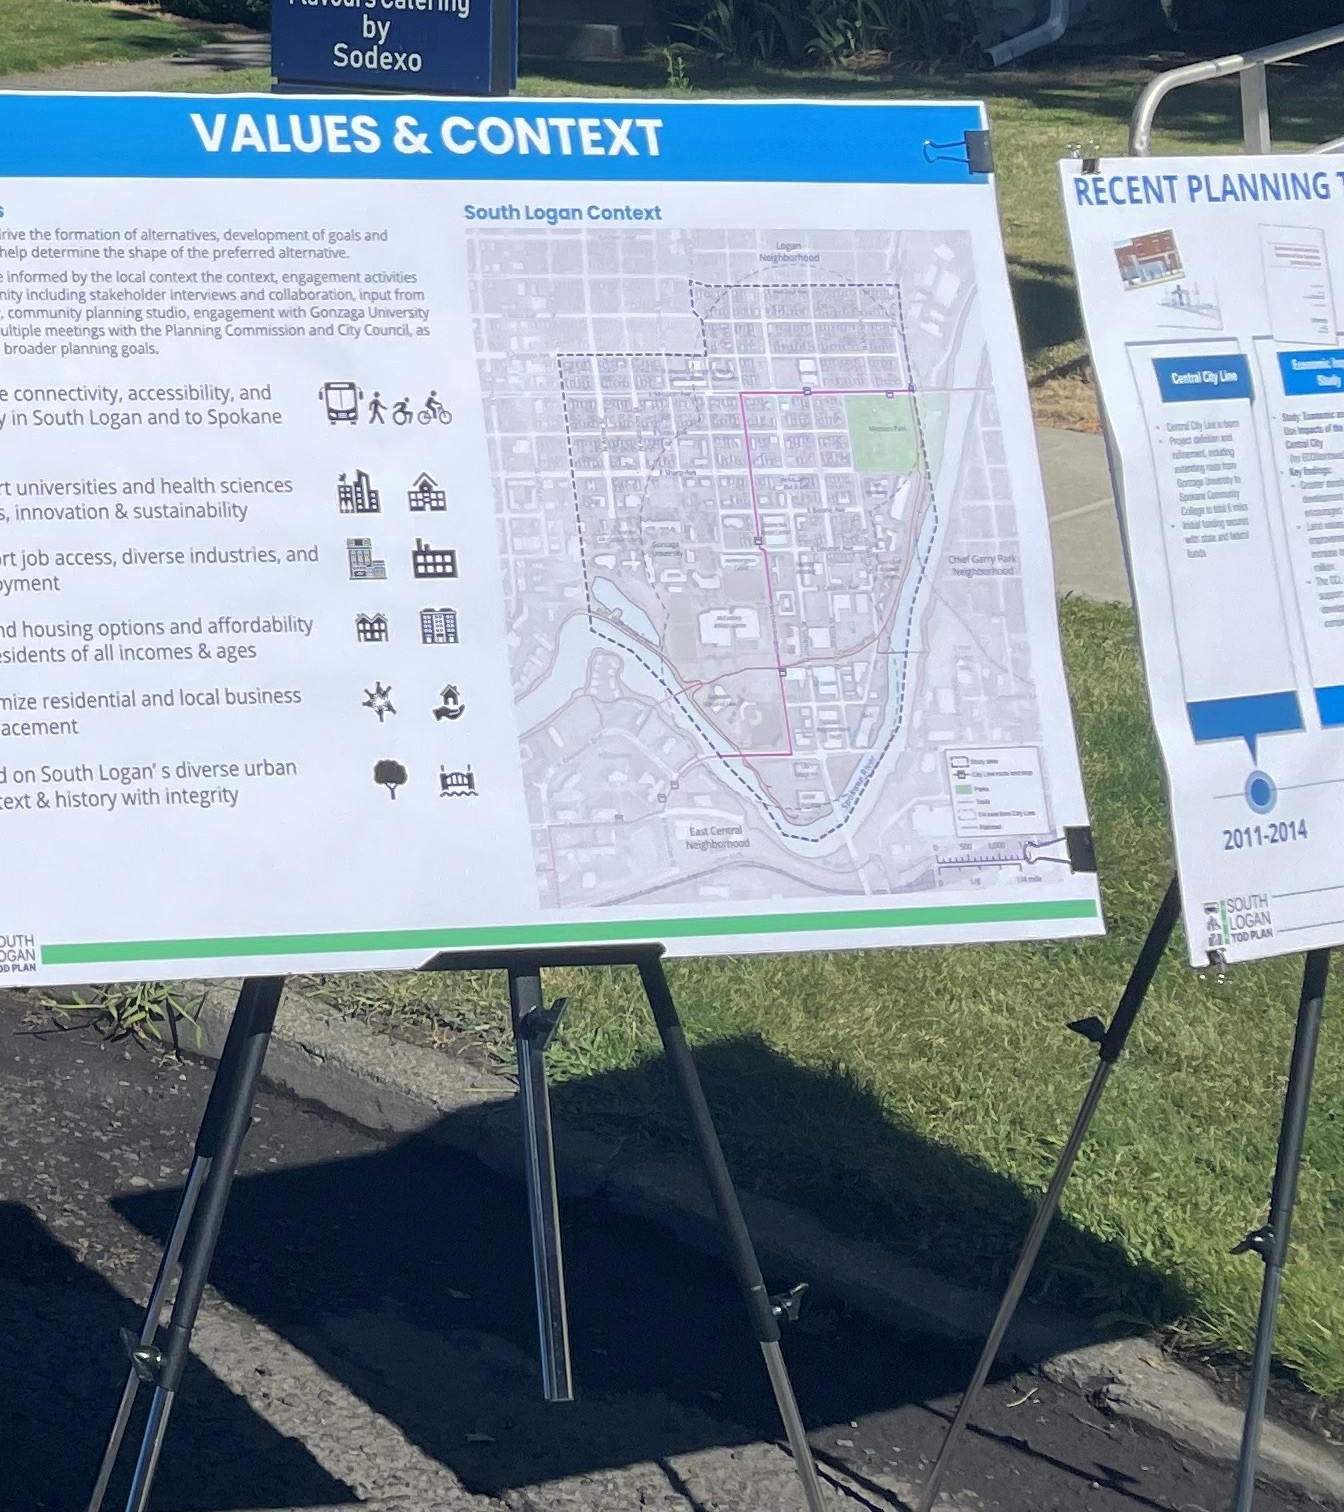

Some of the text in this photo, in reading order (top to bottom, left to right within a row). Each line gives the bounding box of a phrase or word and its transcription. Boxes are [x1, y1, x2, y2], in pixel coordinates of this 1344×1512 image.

[362, 15, 390, 41] by
[333, 44, 422, 72] Sodexo
[190, 113, 663, 156] VALUES & CONTEXT
[1073, 172, 1331, 206] RECENT PLANNING
[464, 204, 662, 225] South Logan Context
[29, 227, 51, 240] the
[55, 227, 121, 241] formation
[124, 228, 137, 240] of
[141, 228, 219, 242] alternatives,
[223, 228, 309, 244] development
[312, 228, 325, 241] of
[328, 228, 361, 245] goals
[364, 229, 388, 242] and
[776, 241, 802, 252] Logan
[0, 245, 27, 262] help
[31, 245, 100, 259] determine
[103, 245, 125, 259] the
[128, 245, 167, 262] shape
[170, 245, 184, 259] of
[187, 245, 209, 259] the
[212, 245, 275, 262] preferred
[278, 245, 349, 259] alternative.
[759, 253, 820, 264] Neighborhood
[1171, 370, 1238, 386] Central City Line
[14, 385, 122, 406] connectivity,
[128, 383, 234, 405] accessibility,
[239, 383, 271, 400] and
[11, 409, 27, 426] in
[32, 408, 84, 426] South
[89, 409, 142, 430] Logan
[148, 408, 180, 425] and
[185, 410, 202, 425] to
[207, 407, 282, 429] Spokane
[16, 478, 117, 496] universities
[122, 477, 155, 494] and
[160, 476, 215, 494] health
[220, 476, 293, 493] sciences
[15, 503, 109, 520] innovation
[115, 503, 128, 519] &
[133, 501, 248, 523] sustainability
[22, 548, 49, 571] job
[55, 552, 116, 568] access,
[122, 547, 184, 565] diverse
[190, 545, 280, 565] industries,
[286, 544, 318, 562] and
[22, 619, 93, 642] housing
[98, 618, 165, 641] options
[170, 617, 202, 635] and
[208, 615, 313, 638] affordability
[71, 644, 88, 662] of
[94, 643, 114, 662] all
[119, 643, 193, 661] incomes
[198, 642, 211, 659] &
[216, 645, 256, 663] ages
[42, 689, 136, 710] residential
[141, 688, 174, 707] and
[179, 687, 219, 706] local
[225, 686, 301, 705] business
[13, 769, 36, 784] on
[41, 763, 93, 783] South
[175, 759, 239, 779] diverse
[244, 757, 296, 776] urban
[36, 791, 50, 808] &
[55, 789, 117, 812] history
[121, 787, 160, 806] with
[165, 785, 239, 809] integrity
[689, 824, 743, 837] East Central
[1222, 819, 1308, 850] 2011-2014
[686, 838, 751, 852] Neighborhood
[1226, 894, 1268, 912] SOUTH
[1229, 912, 1271, 930] LOGAN
[1231, 927, 1273, 942] TOD PLAN
[10, 962, 36, 973] PLAN
